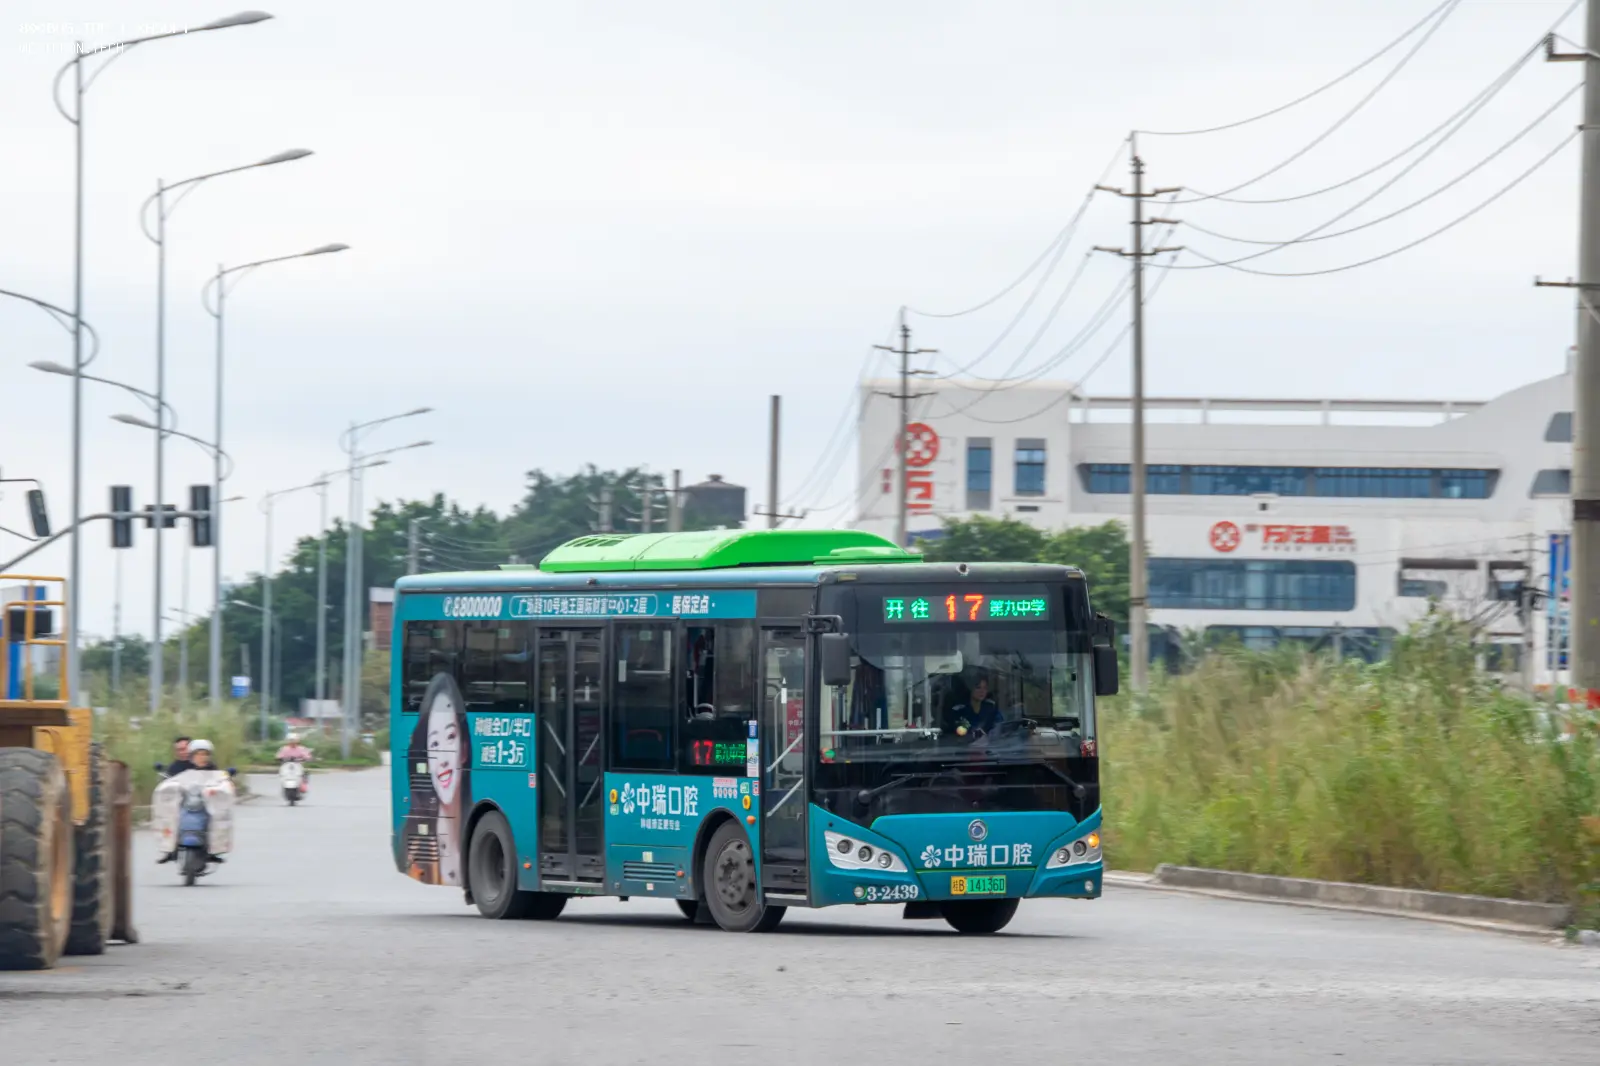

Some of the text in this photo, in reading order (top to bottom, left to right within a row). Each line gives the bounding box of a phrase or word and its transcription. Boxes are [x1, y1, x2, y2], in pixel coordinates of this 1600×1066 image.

[886, 594, 1045, 621] 开往 17 第九中学
[693, 740, 714, 764] 17
[636, 783, 698, 816] 中瑞口腔
[944, 843, 1033, 868] 中瑞口腔
[866, 884, 919, 901] 3-2439
